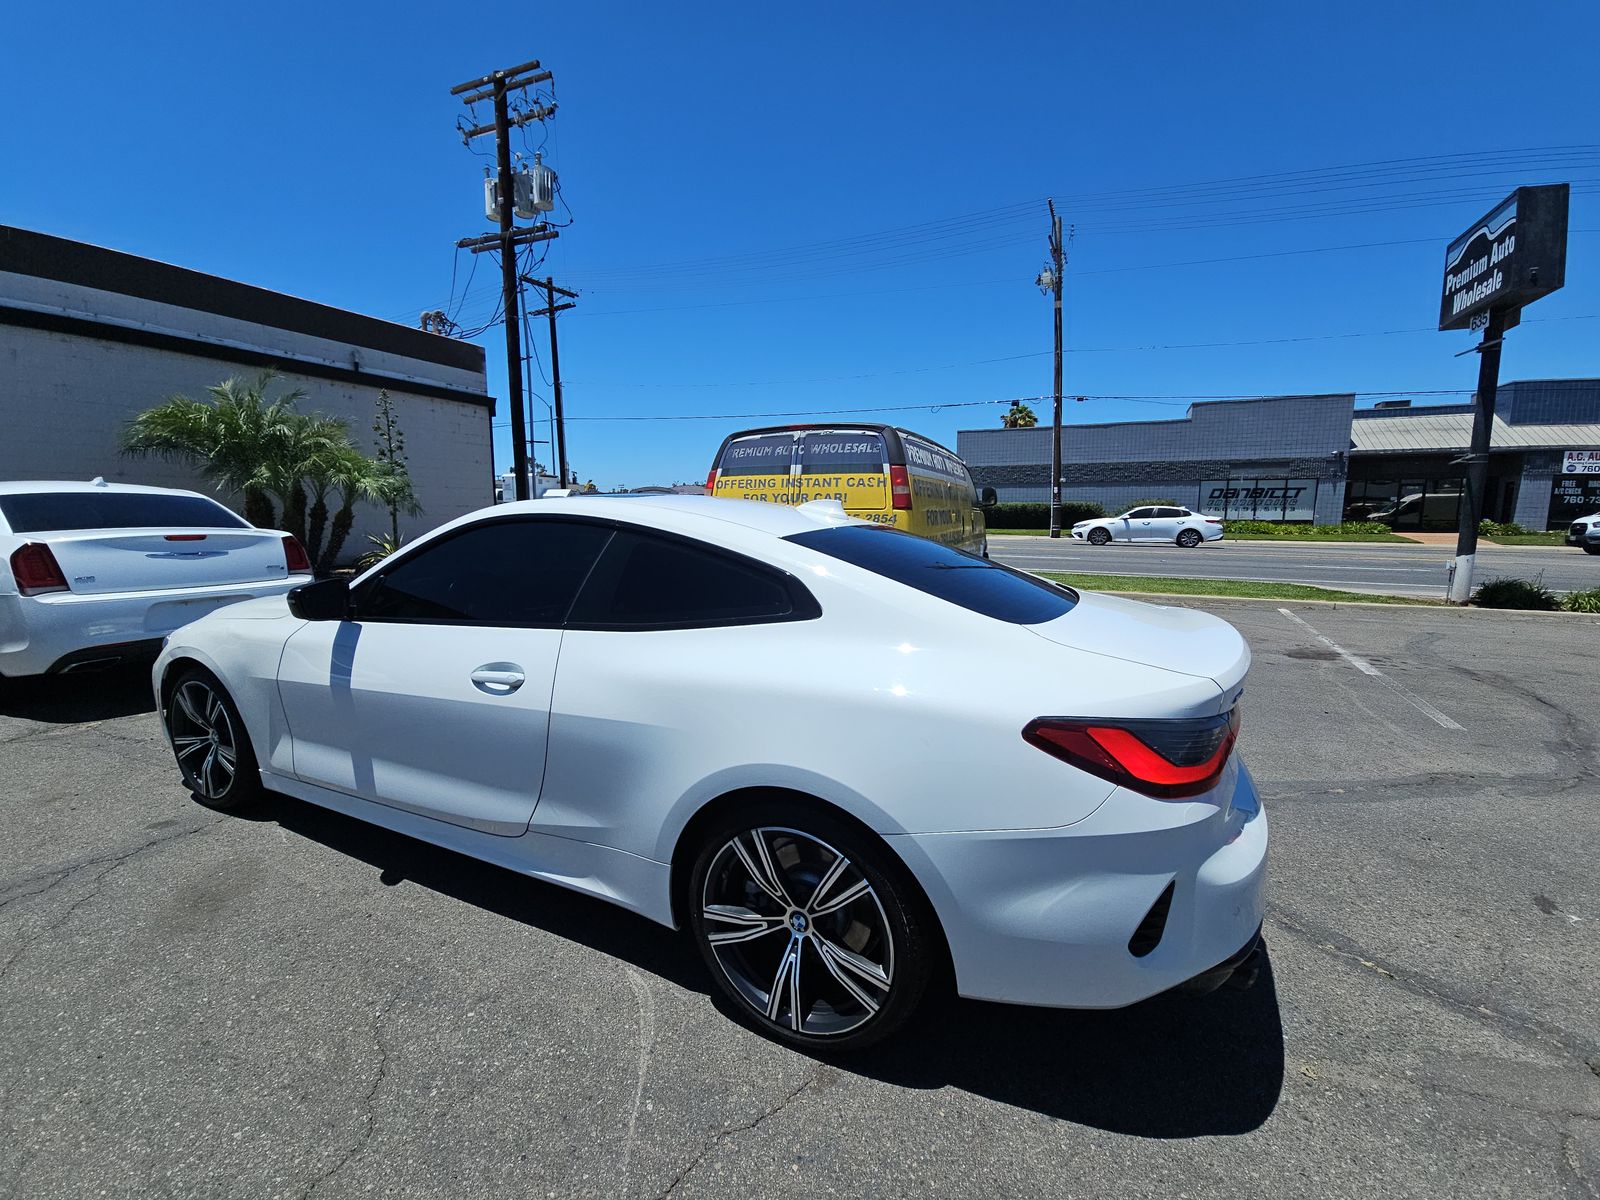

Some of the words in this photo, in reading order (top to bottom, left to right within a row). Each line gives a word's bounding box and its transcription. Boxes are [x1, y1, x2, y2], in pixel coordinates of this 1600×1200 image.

[1445, 254, 1488, 296] Premium
[1489, 235, 1516, 267] Auto
[1453, 268, 1502, 315] Wholesale
[1471, 314, 1488, 331] 635
[811, 443, 882, 454] WHOLESALE
[1567, 452, 1586, 461] A.C.
[716, 478, 776, 490] OFFERING
[781, 477, 841, 489] INSTANT
[846, 477, 887, 488] CASH
[744, 493, 768, 502] FOR
[774, 493, 809, 504] YOUR
[815, 492, 848, 503] CAR!
